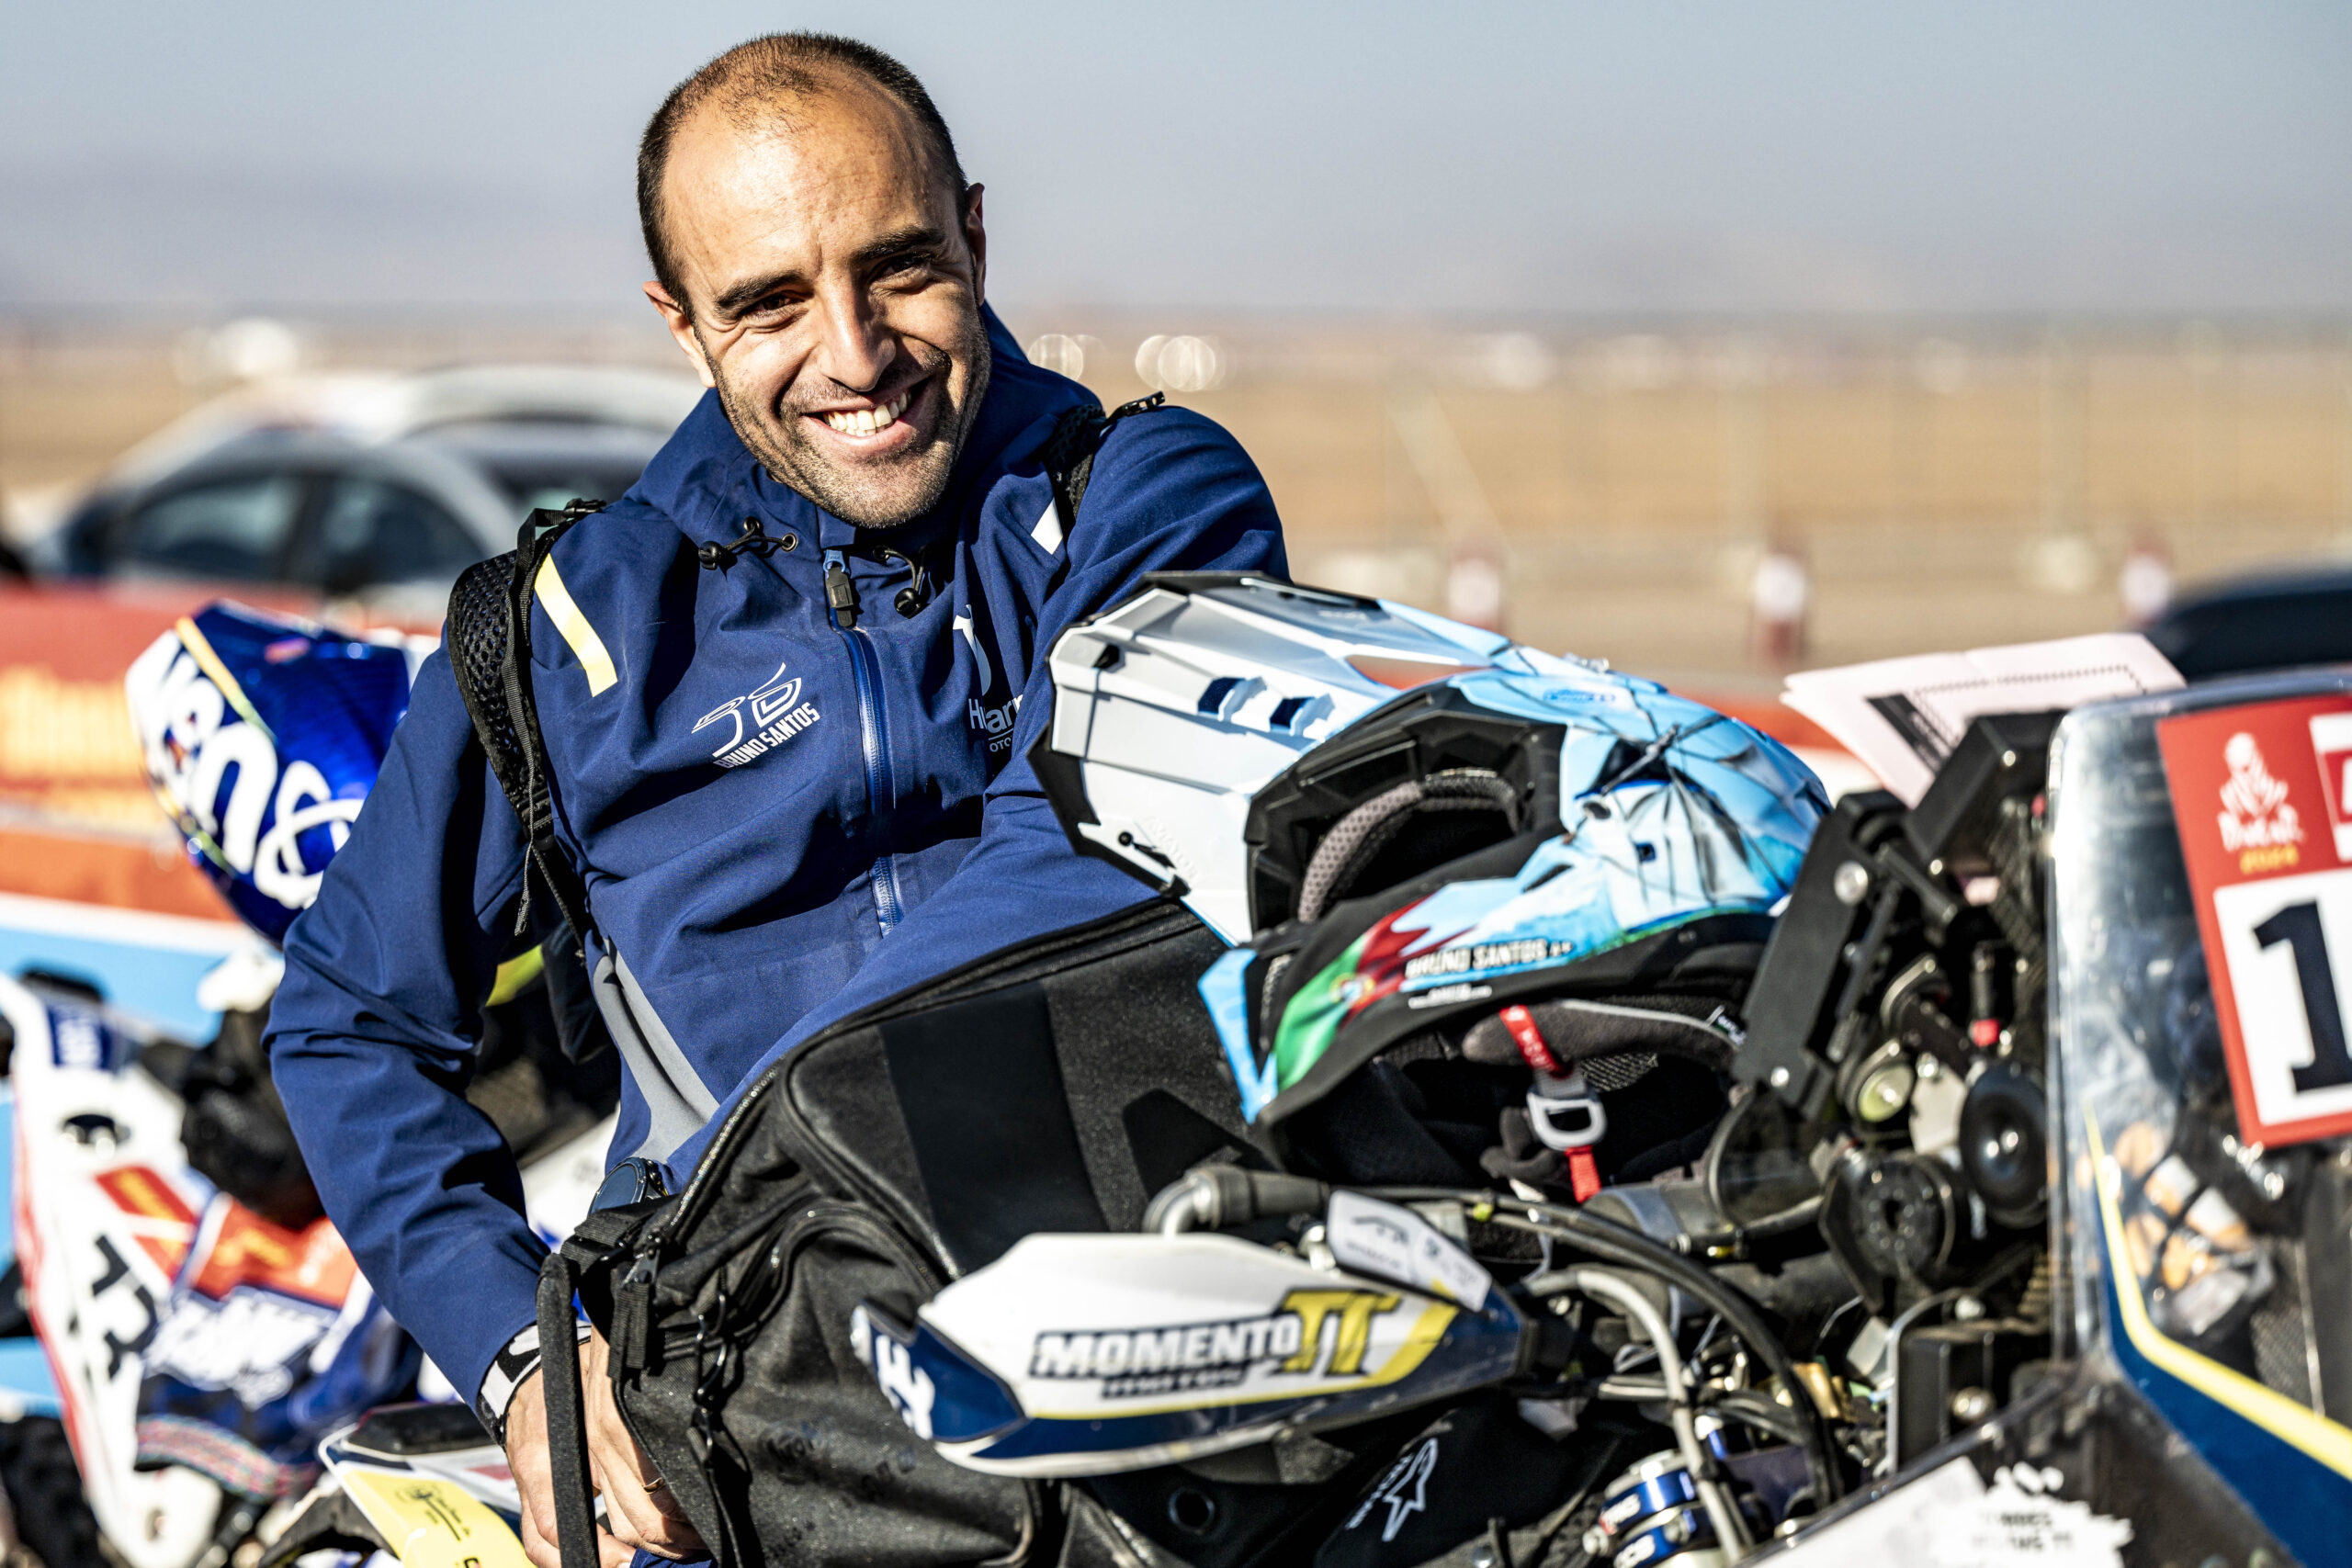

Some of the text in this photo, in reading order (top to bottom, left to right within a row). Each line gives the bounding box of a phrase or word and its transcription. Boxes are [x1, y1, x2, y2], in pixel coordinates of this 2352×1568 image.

[712, 702, 820, 769] BRUNO SANTOS
[1405, 947, 1471, 979] BRUNO
[1472, 937, 1548, 969] SANTOS
[1031, 1312, 1303, 1376] MOMENTO
